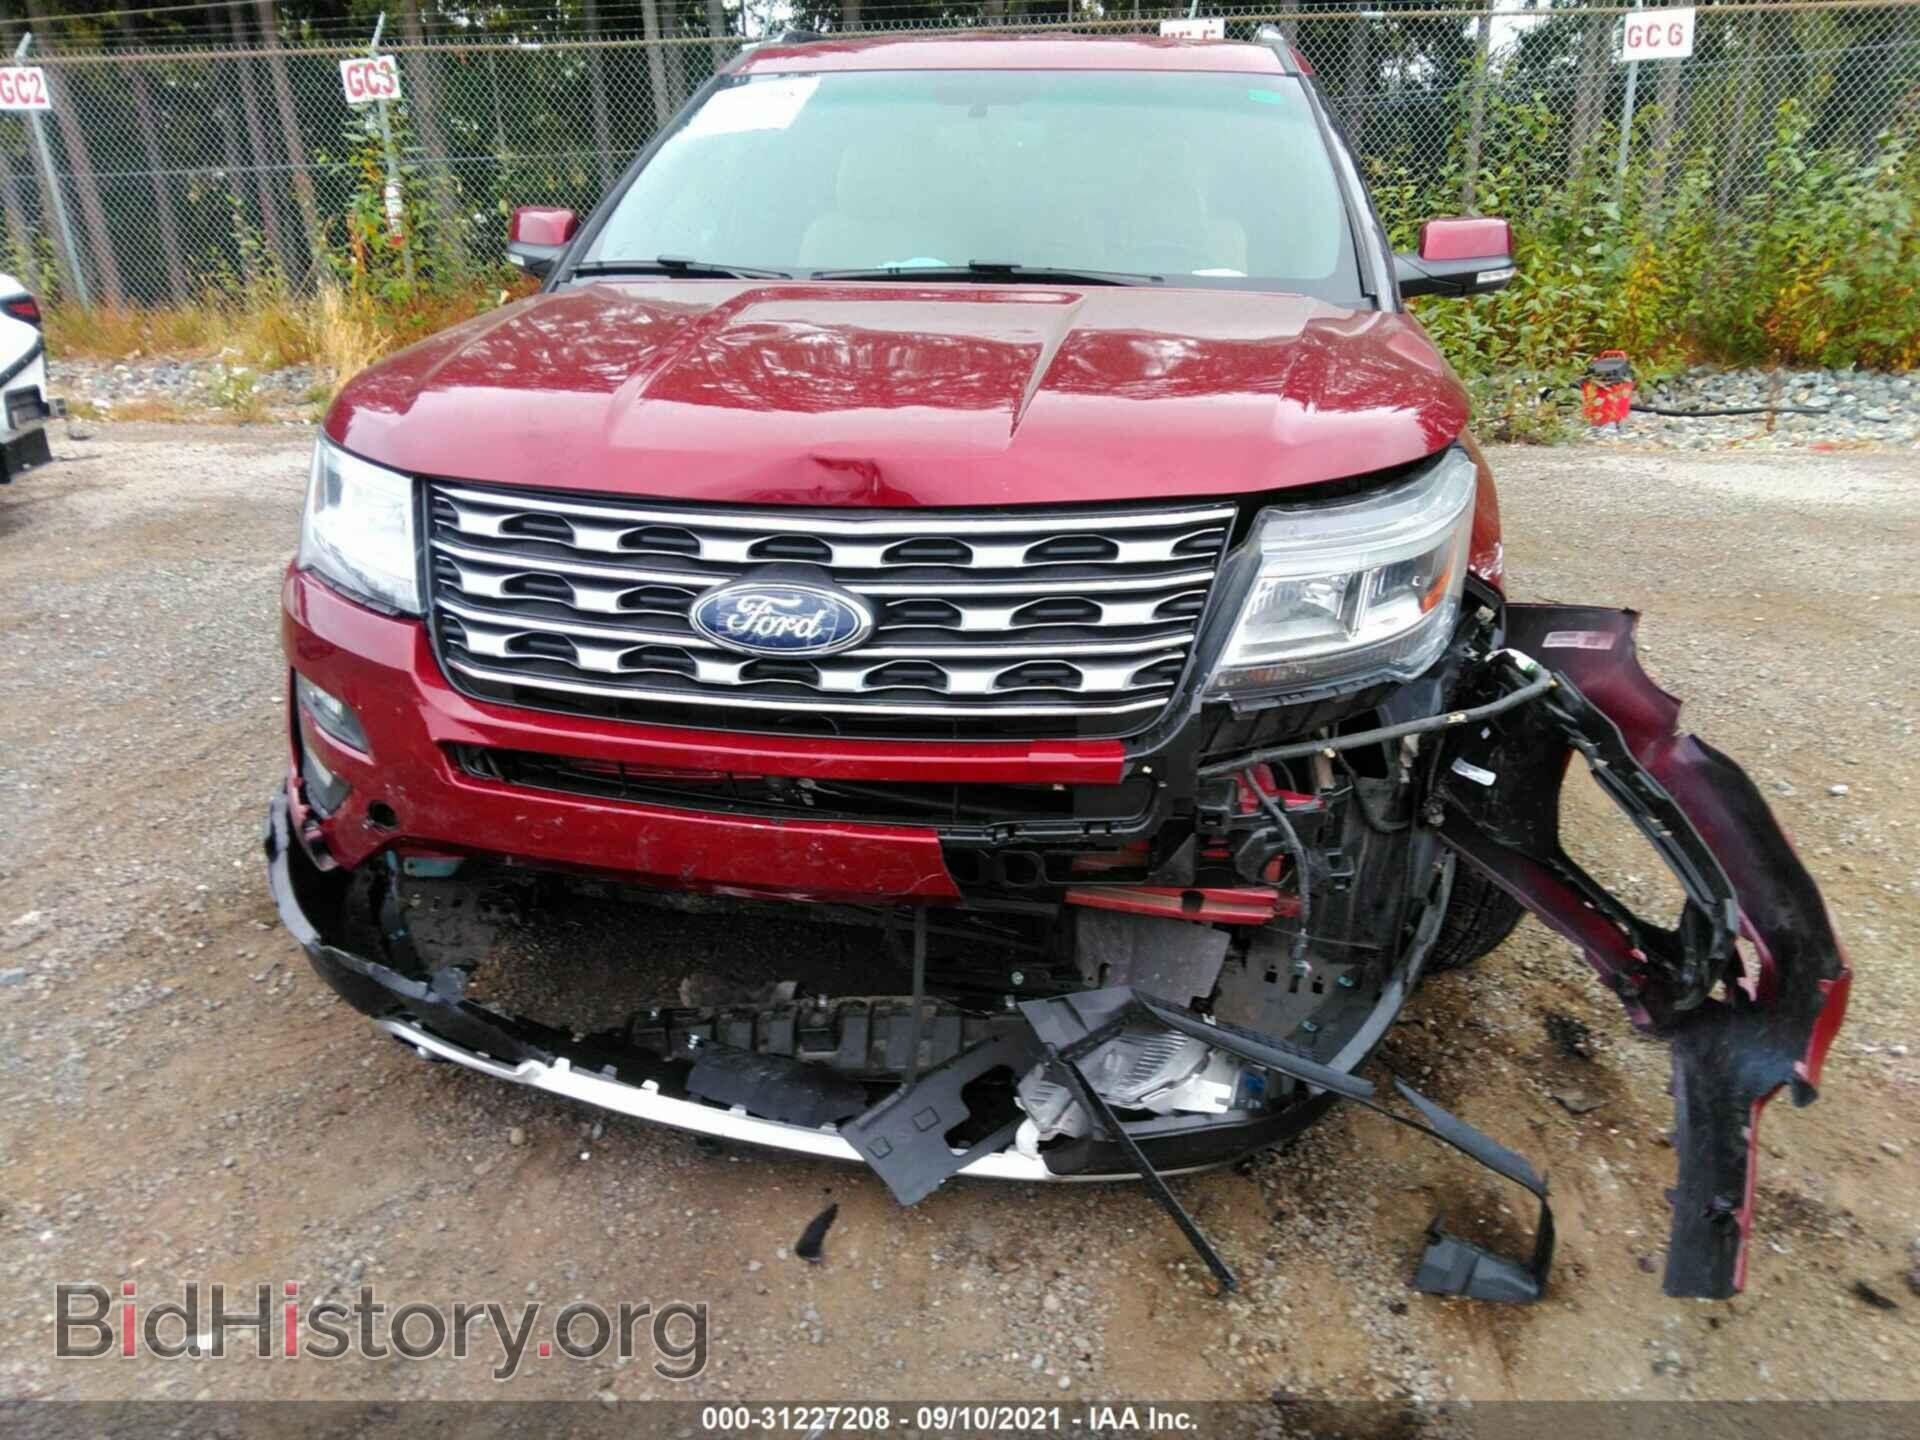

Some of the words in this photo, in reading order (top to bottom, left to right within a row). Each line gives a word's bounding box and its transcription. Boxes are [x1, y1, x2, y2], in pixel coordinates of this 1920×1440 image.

[0, 71, 46, 105] GC2
[346, 60, 395, 97] GC3
[726, 593, 827, 641] Ford
